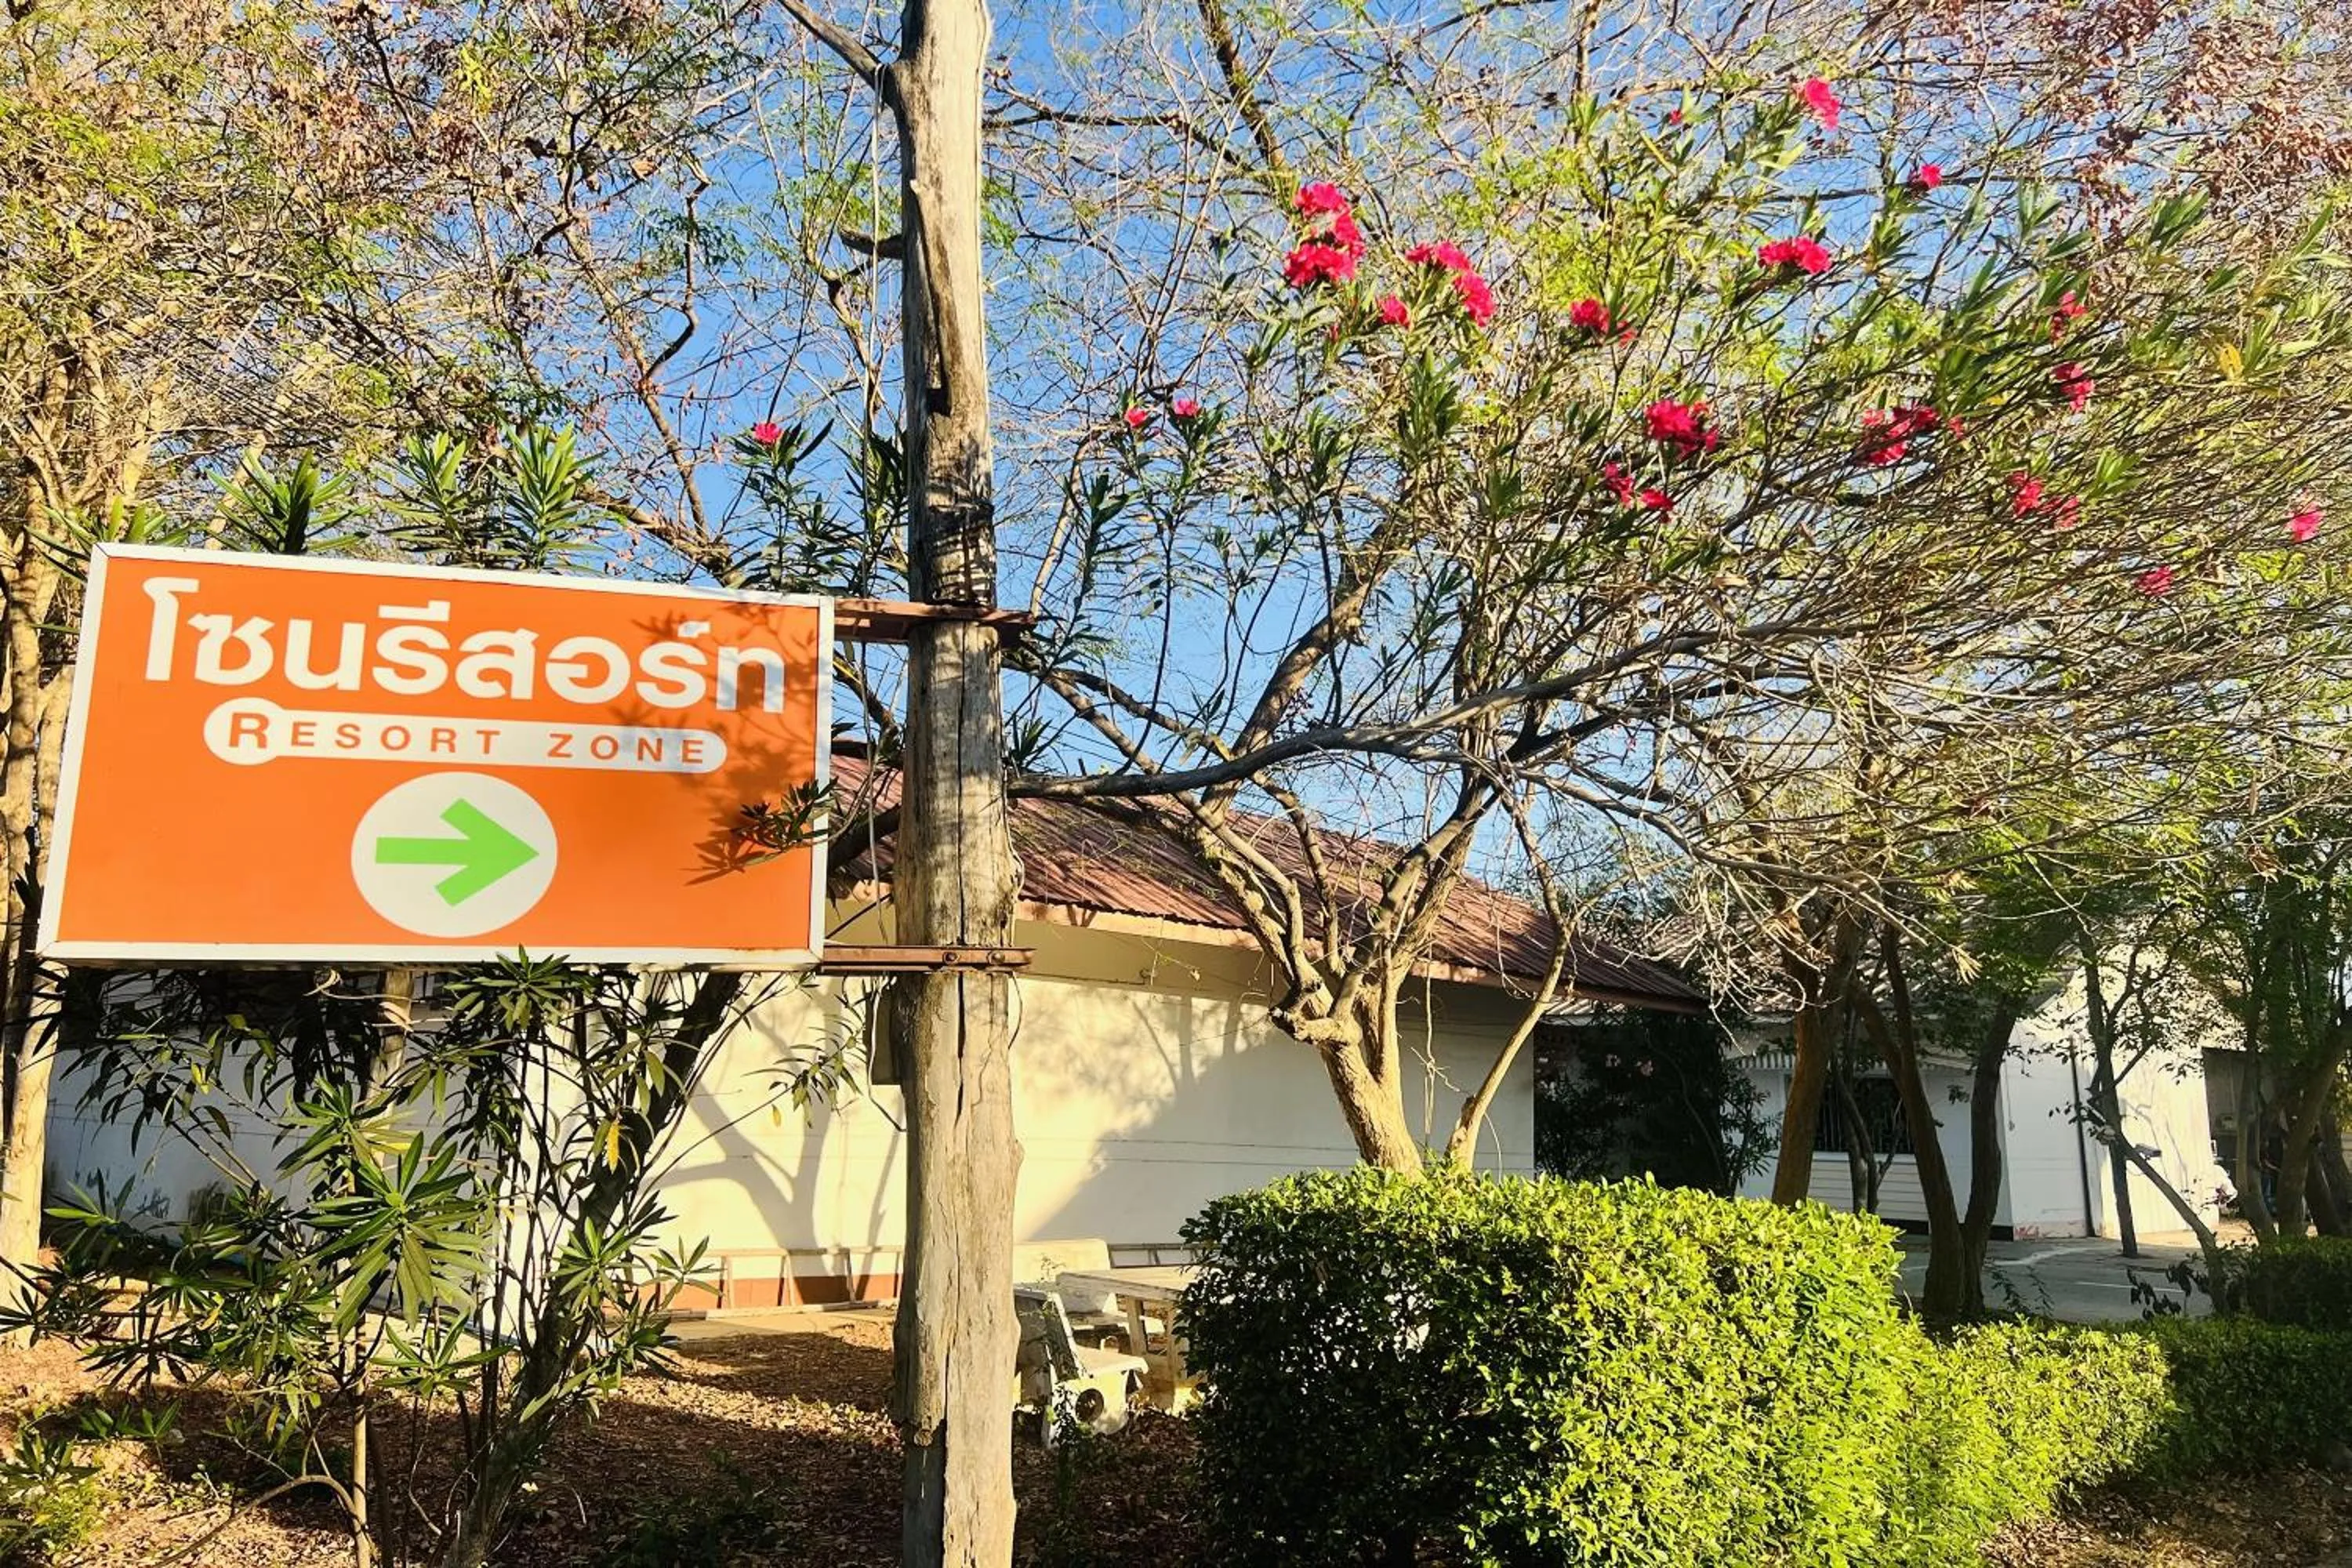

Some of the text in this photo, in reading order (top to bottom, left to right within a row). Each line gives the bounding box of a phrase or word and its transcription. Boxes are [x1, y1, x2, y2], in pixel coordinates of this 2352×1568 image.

[143, 576, 785, 713] โซนรีสอร์ท
[228, 712, 704, 764] RESORT ZONE
